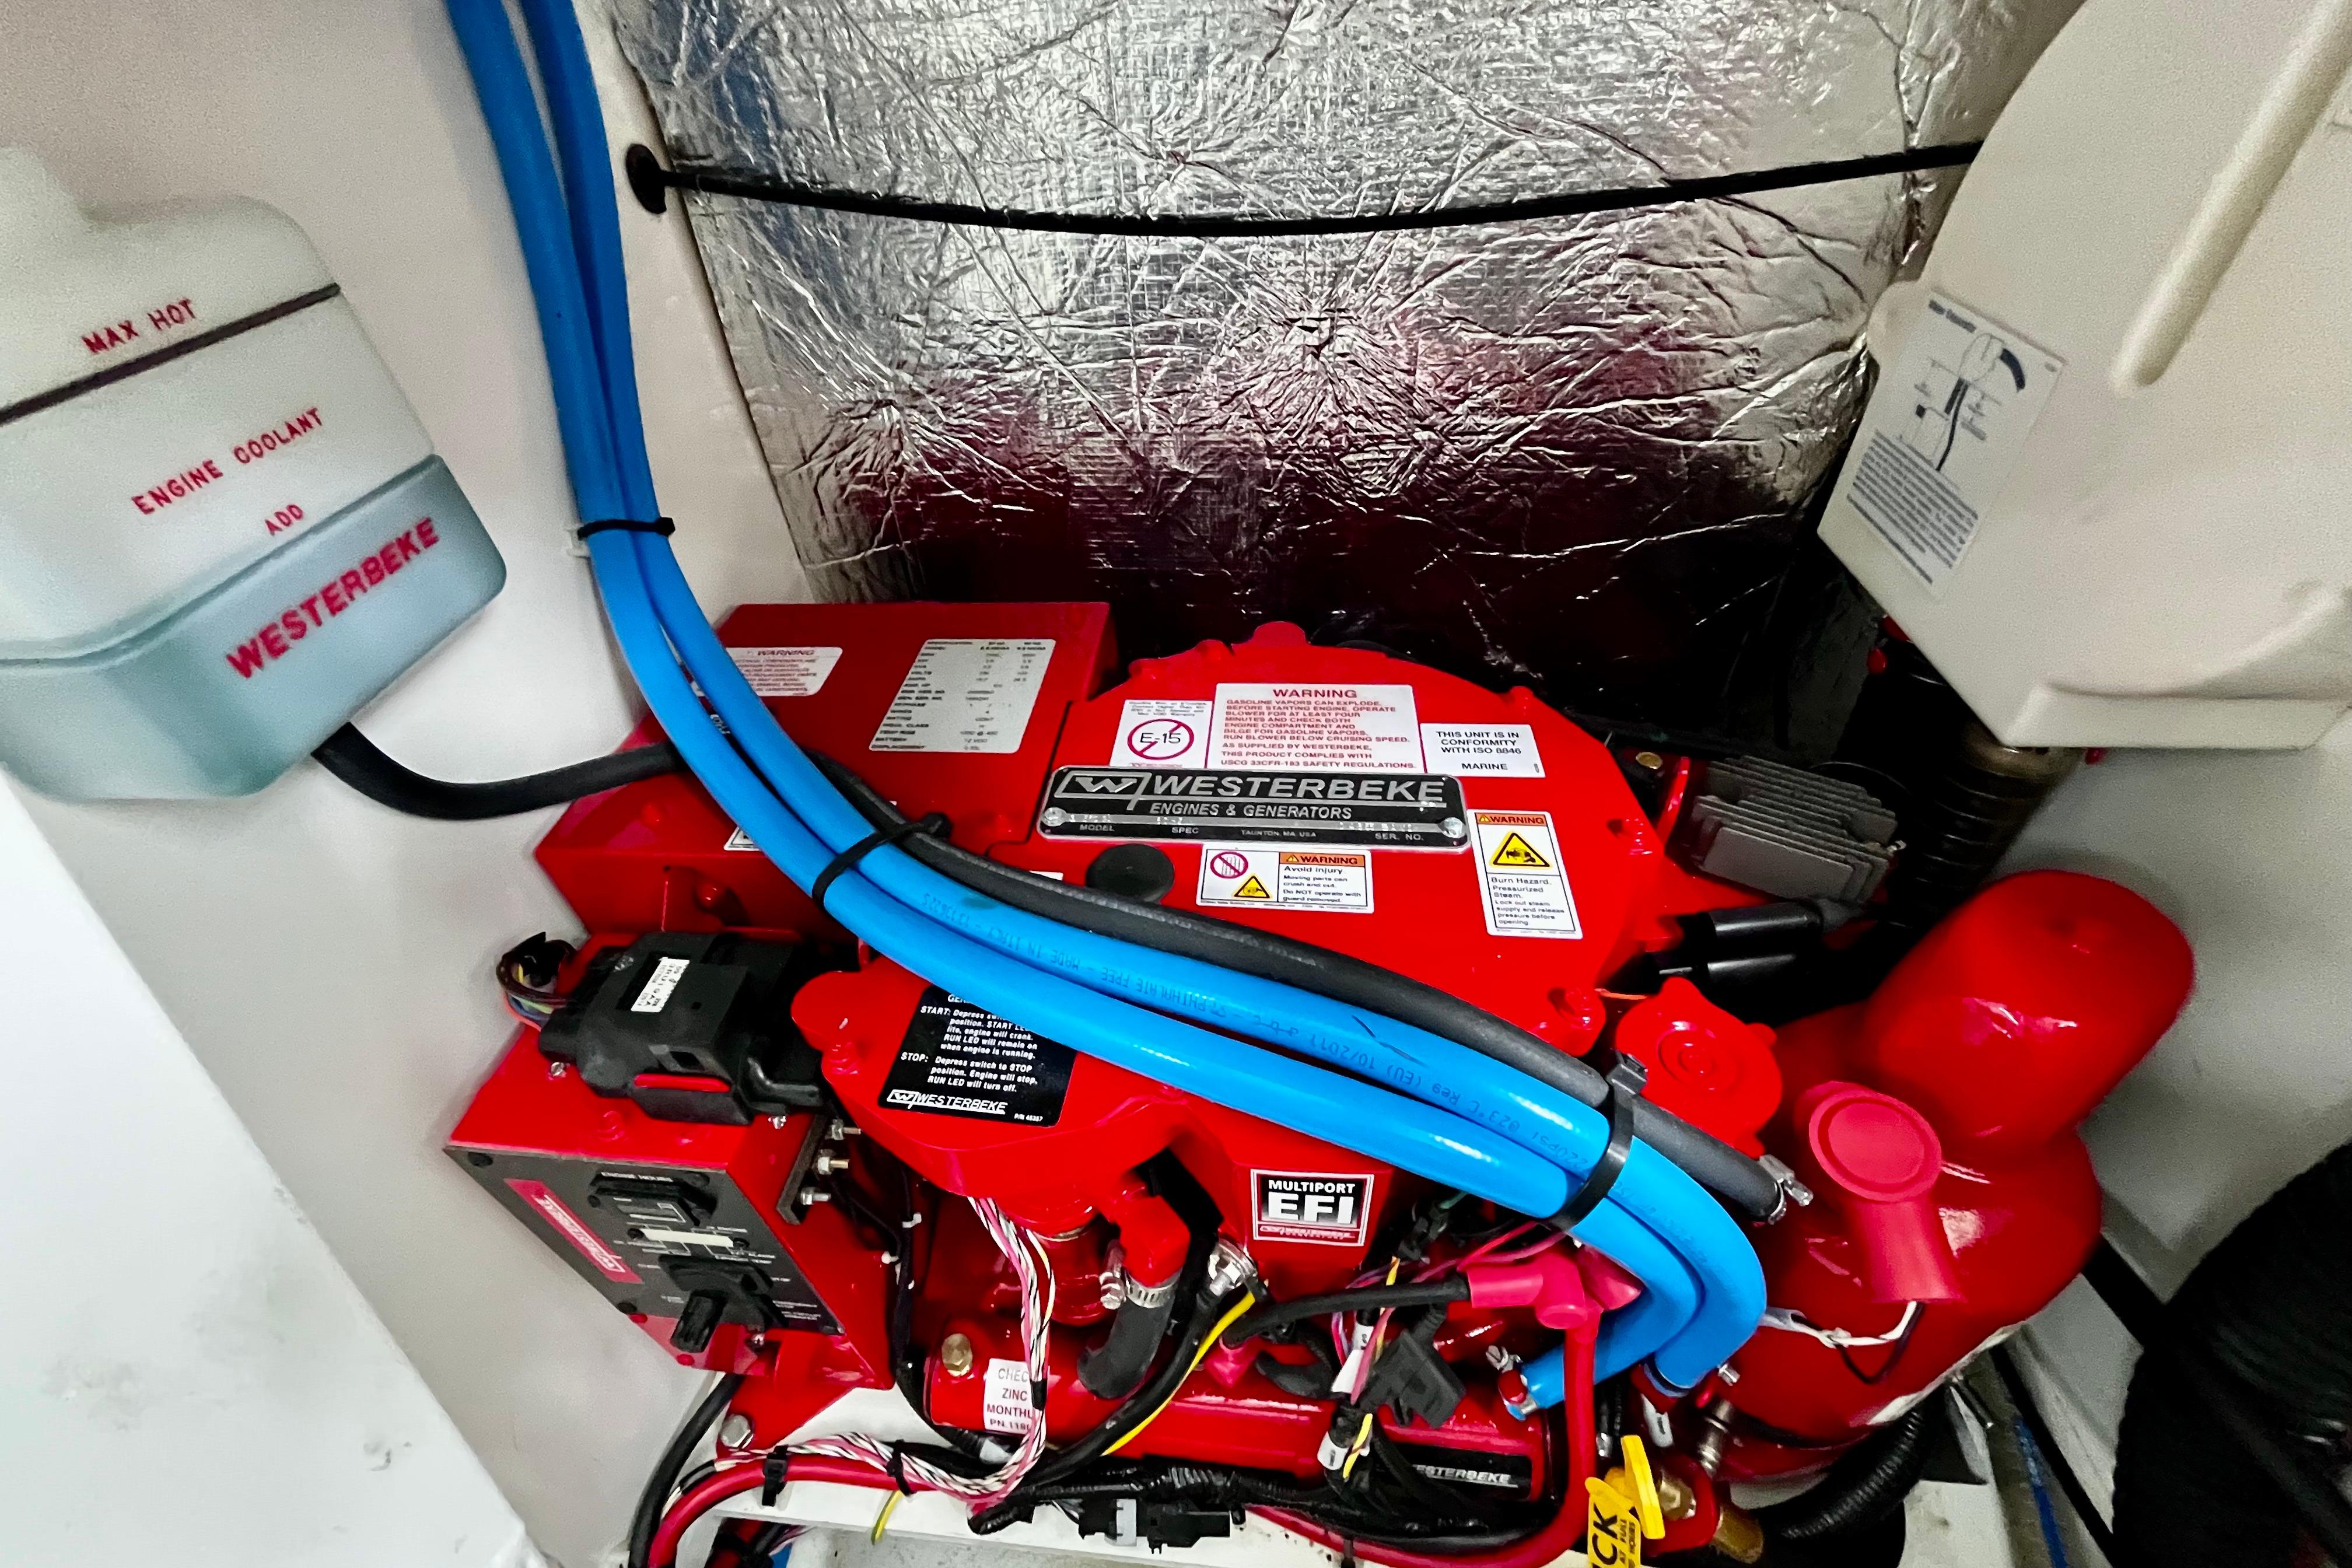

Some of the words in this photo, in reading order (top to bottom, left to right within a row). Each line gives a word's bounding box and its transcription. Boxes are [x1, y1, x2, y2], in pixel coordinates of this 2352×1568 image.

[81, 320, 139, 354] MAX
[148, 299, 197, 331] HOT
[131, 460, 223, 515] ENGINE
[233, 408, 323, 464] COOLANT
[264, 504, 304, 536] ADD
[226, 517, 439, 680] WESTERBEKE
[1273, 689, 1357, 698] WARNING
[1140, 733, 1181, 744] E-15
[1153, 775, 1445, 802] WESTERBEKE
[1150, 803, 1219, 816] ENGINES
[1226, 804, 1236, 817] &
[1243, 804, 1352, 820] GENERATORS
[1490, 816, 1544, 824] WARNING
[1301, 855, 1358, 864] WARNING
[1027, 940, 1041, 959] IN
[1050, 949, 1082, 971] MADE
[921, 1006, 951, 1016] START:
[953, 1010, 984, 1019] Depress
[949, 1019, 984, 1027] position.
[986, 1021, 1013, 1030] START
[964, 1028, 991, 1037] engine
[943, 1034, 962, 1042] RUN
[963, 1035, 979, 1044] LED
[963, 1046, 991, 1055] engine
[1002, 1050, 1036, 1060] running.
[1311, 1034, 1375, 1069] 10/2011
[901, 1052, 929, 1063] STOP:
[935, 1056, 968, 1066] Depress
[970, 1060, 996, 1069] switch
[1009, 1063, 1033, 1073] STOP
[930, 1066, 967, 1076] position.
[969, 1069, 998, 1080] Engine
[1000, 1073, 1015, 1082] will
[1387, 1064, 1422, 1087] (EU)
[927, 1075, 946, 1084] RUN
[947, 1077, 965, 1086] LED
[967, 1080, 982, 1088] will
[984, 1082, 1001, 1090] turn
[1002, 1084, 1017, 1092] off.
[916, 1093, 1008, 1111] WESTERBEKE
[1432, 1083, 1461, 1106] Reg
[1268, 1180, 1356, 1194] MULTIPORT
[1268, 1191, 1354, 1224] EFI
[998, 1367, 1030, 1382] CHEC
[1002, 1387, 1028, 1401] ZINC
[987, 1403, 1032, 1419] MONTHL
[1414, 1464, 1512, 1485] ESTERBEKE
